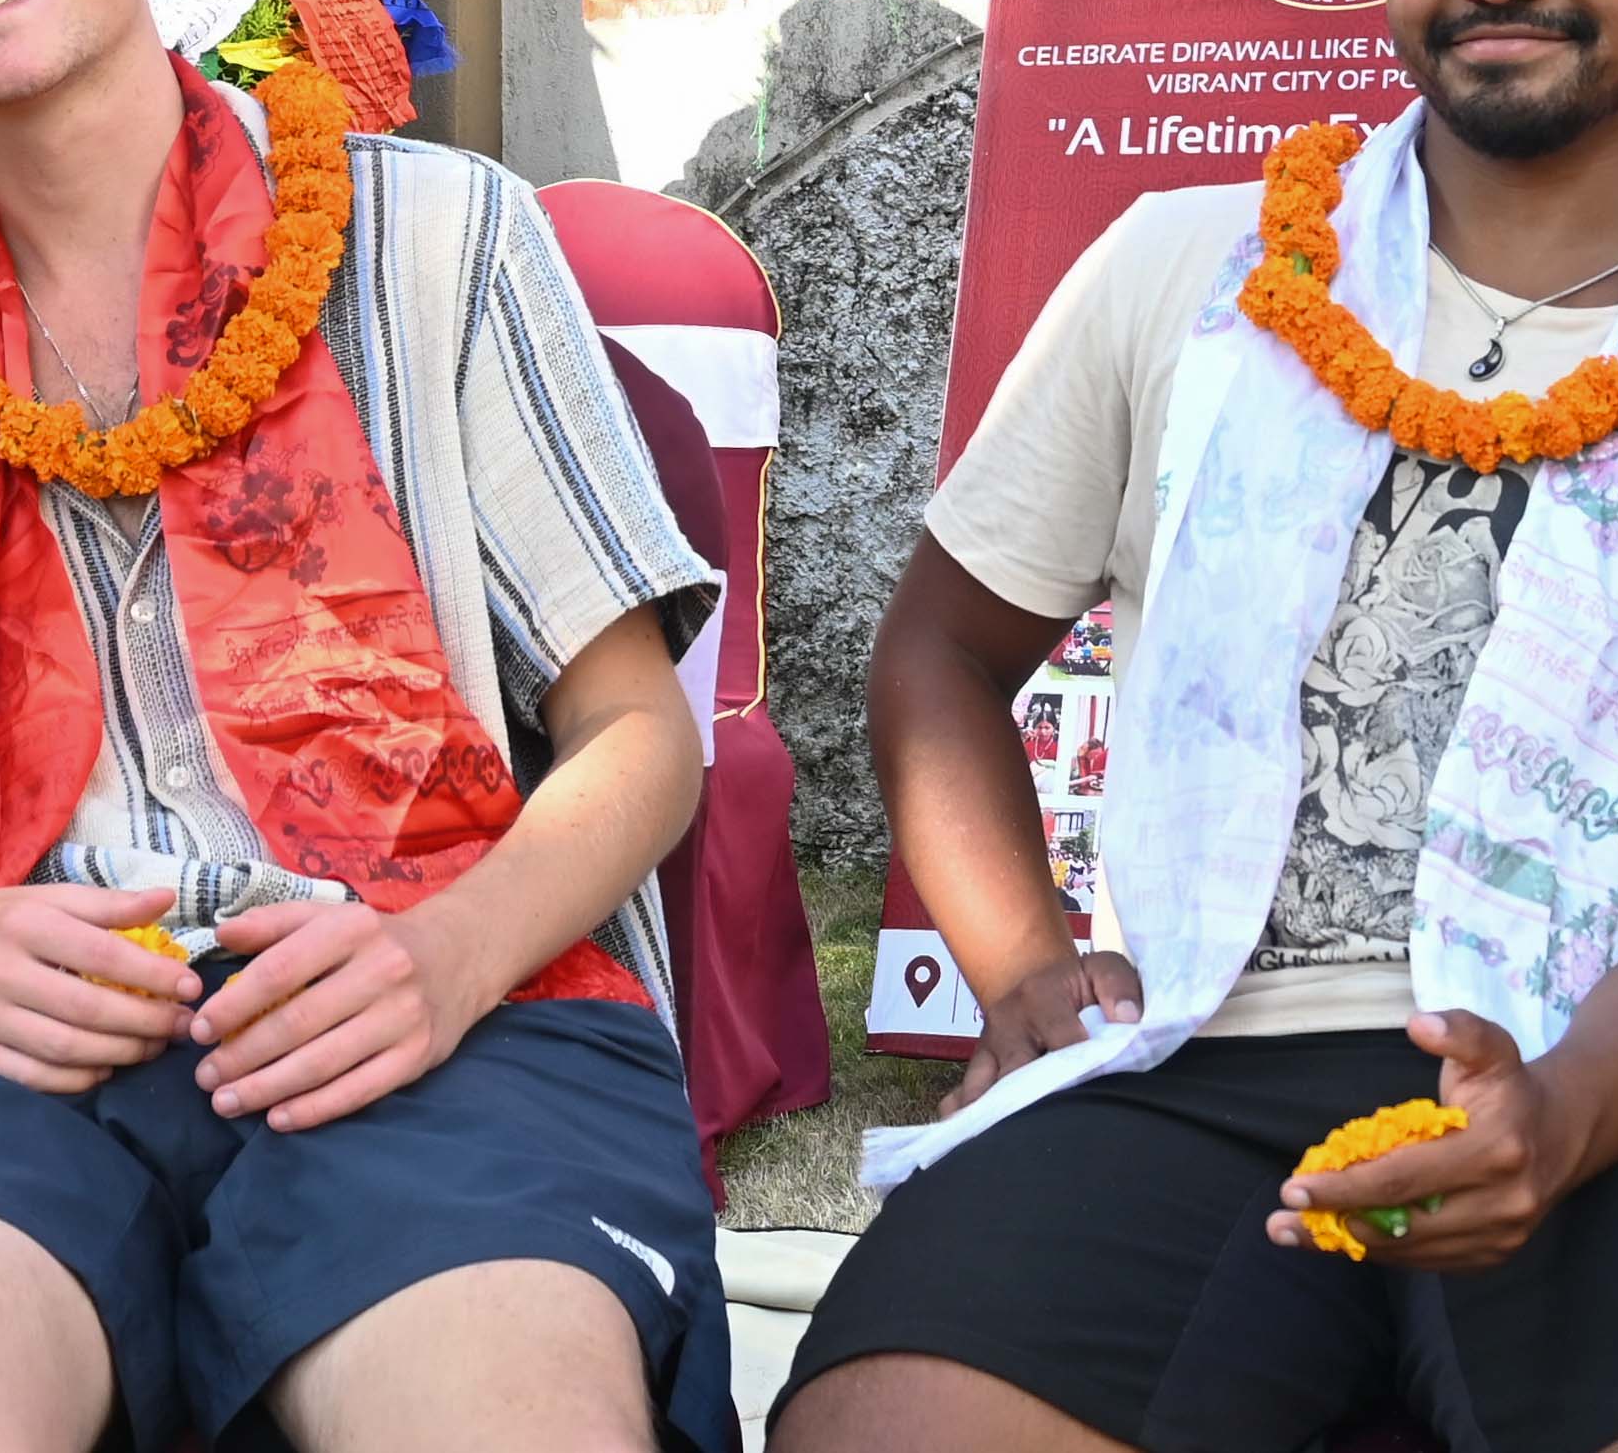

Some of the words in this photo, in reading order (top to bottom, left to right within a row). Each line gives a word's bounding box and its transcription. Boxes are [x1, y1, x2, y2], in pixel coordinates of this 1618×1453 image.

[1017, 42, 1166, 66] CELEBRATE
[1172, 39, 1304, 63] DIPAWALI
[1310, 37, 1369, 60] LIKE
[1146, 71, 1267, 94] VIBRANT
[1272, 70, 1333, 92] CITY
[1337, 68, 1376, 91] OF
